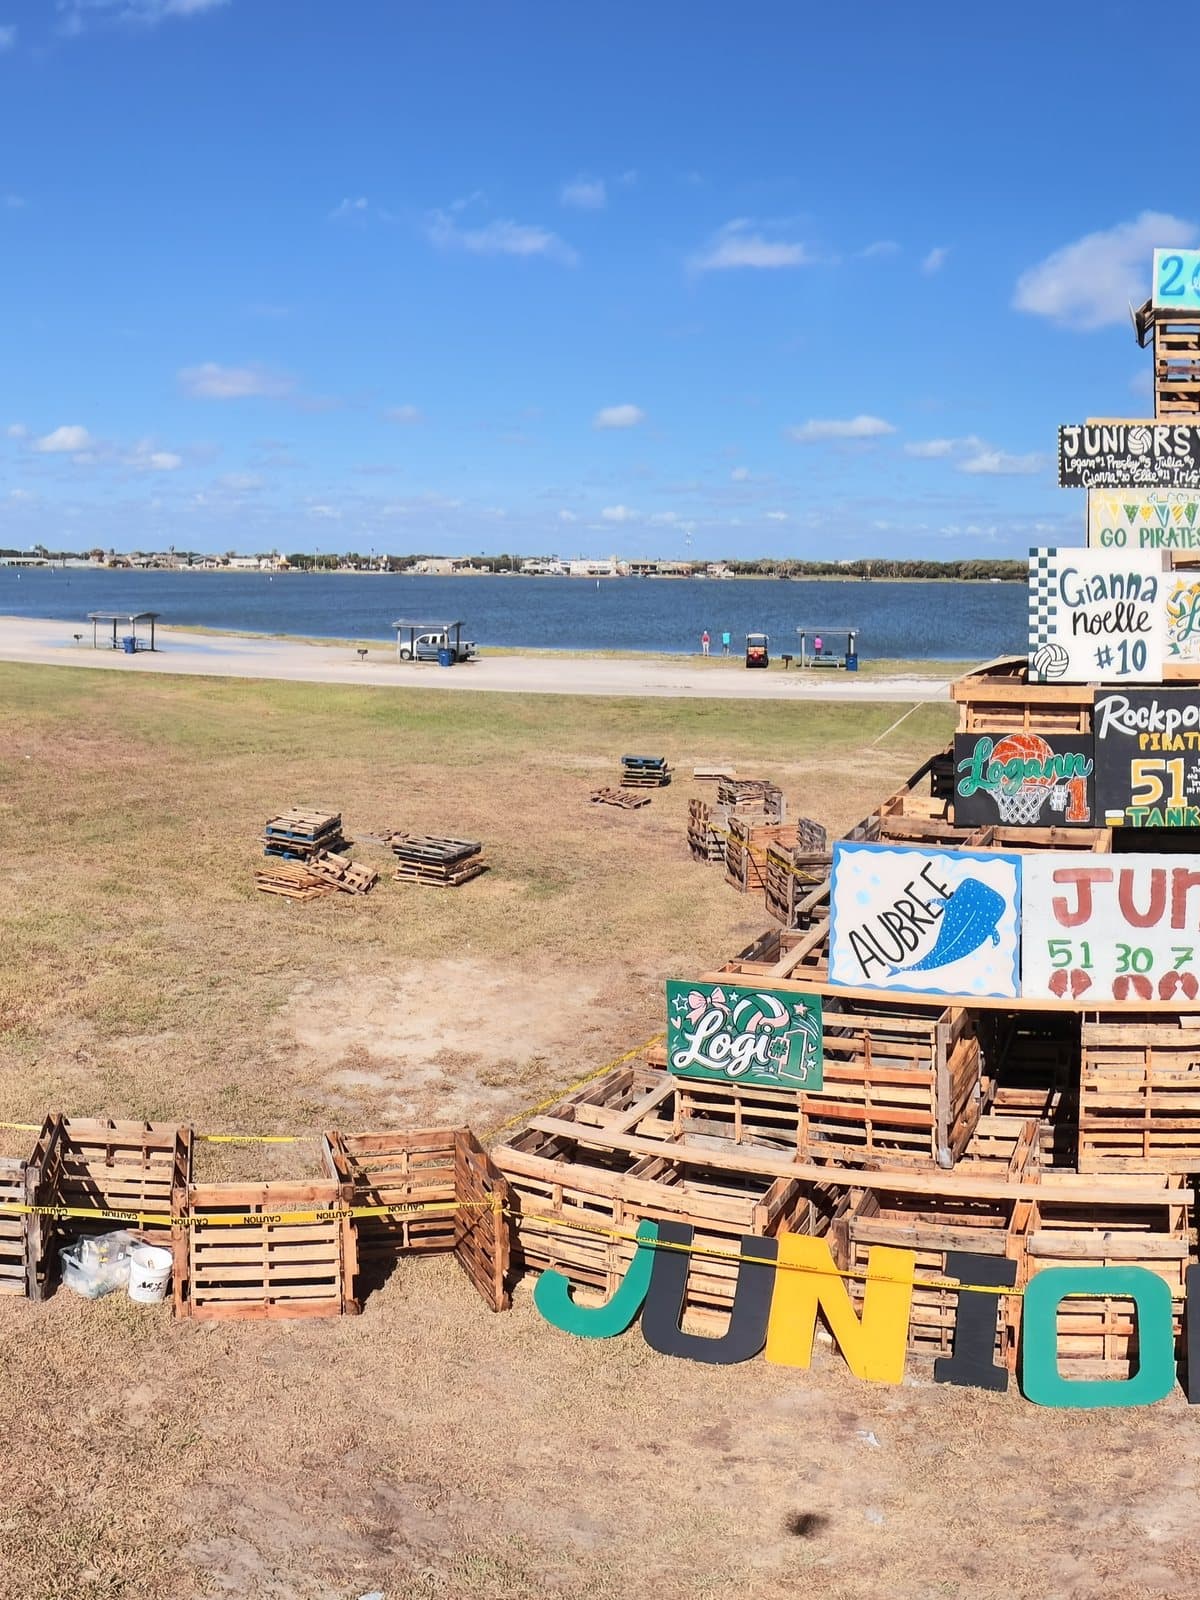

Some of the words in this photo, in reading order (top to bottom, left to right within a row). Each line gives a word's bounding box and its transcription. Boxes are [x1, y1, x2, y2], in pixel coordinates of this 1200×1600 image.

[1101, 528, 1127, 547] GO
[1060, 568, 1158, 607] Gianna
[1094, 639, 1147, 675] #10
[957, 736, 1093, 797] Logann
[1131, 758, 1188, 807] 51
[848, 861, 955, 979] AUBREE
[1048, 939, 1094, 969] 51
[1115, 943, 1155, 973] 30
[1171, 947, 1194, 970] 7
[672, 1008, 772, 1077] Logi
[31, 1207, 68, 1216] CAUTION
[101, 1210, 138, 1219] CAUTION
[243, 1215, 281, 1223] CAUTION
[316, 1210, 354, 1219] CAUTION
[388, 1203, 425, 1212] CAUTION
